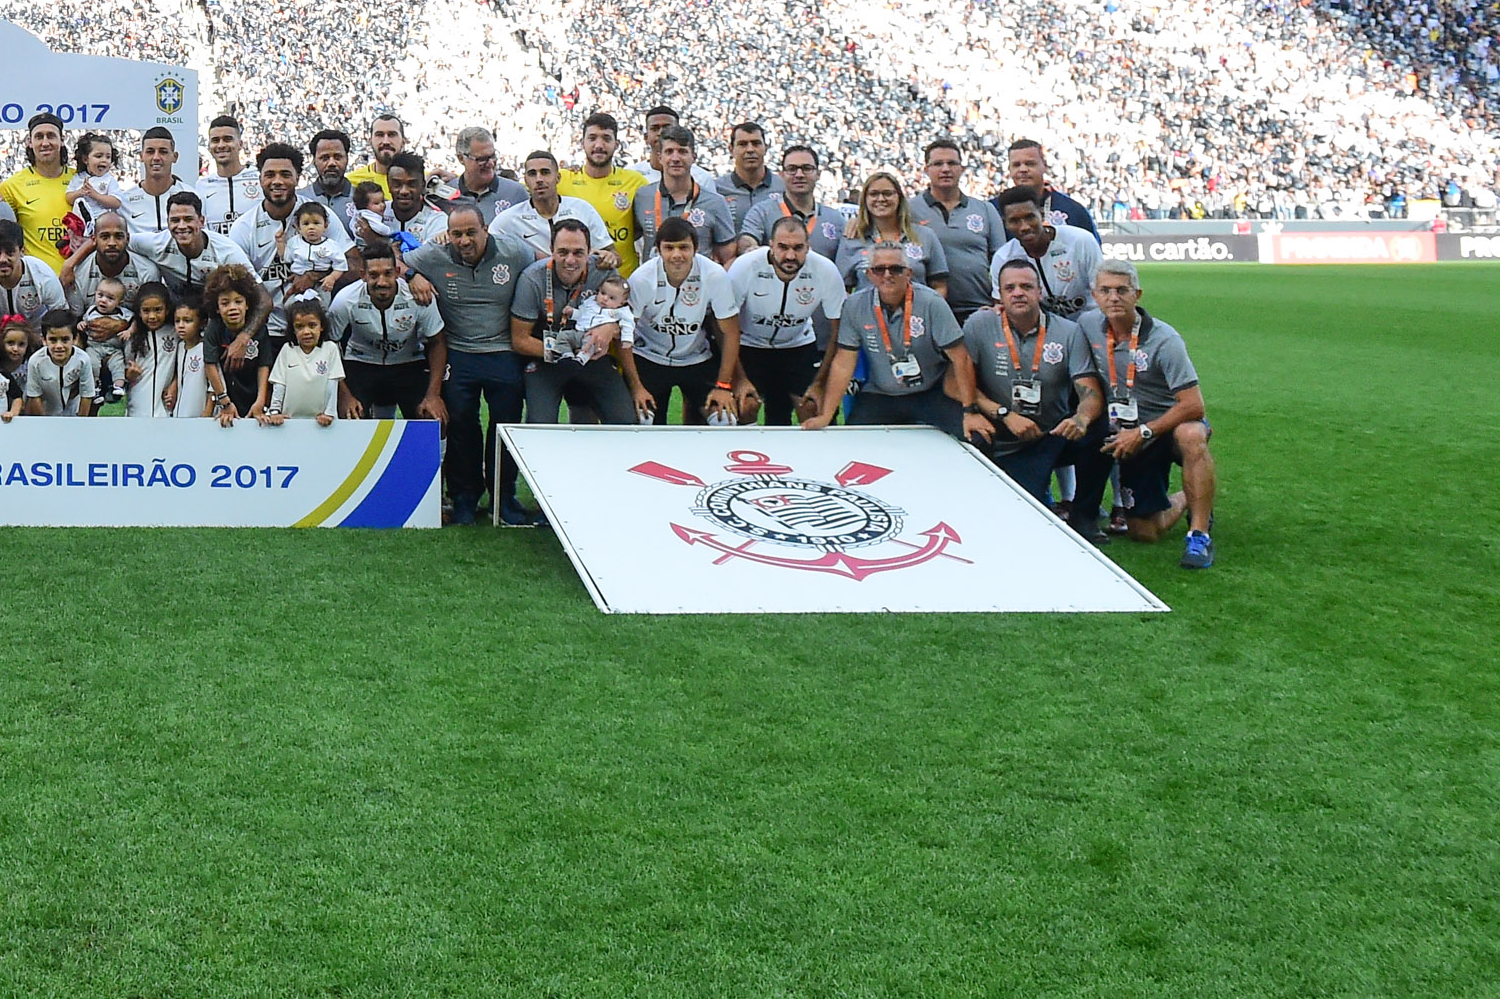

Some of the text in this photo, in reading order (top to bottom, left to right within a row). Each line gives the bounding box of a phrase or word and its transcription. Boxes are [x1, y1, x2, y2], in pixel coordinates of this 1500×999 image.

[156, 116, 184, 124] BRASIL
[1102, 237, 1234, 261] seu cartão.
[211, 465, 300, 489] 2017
[709, 480, 889, 533] CORINTHIANS PAULISTA
[796, 534, 856, 545] 1910
